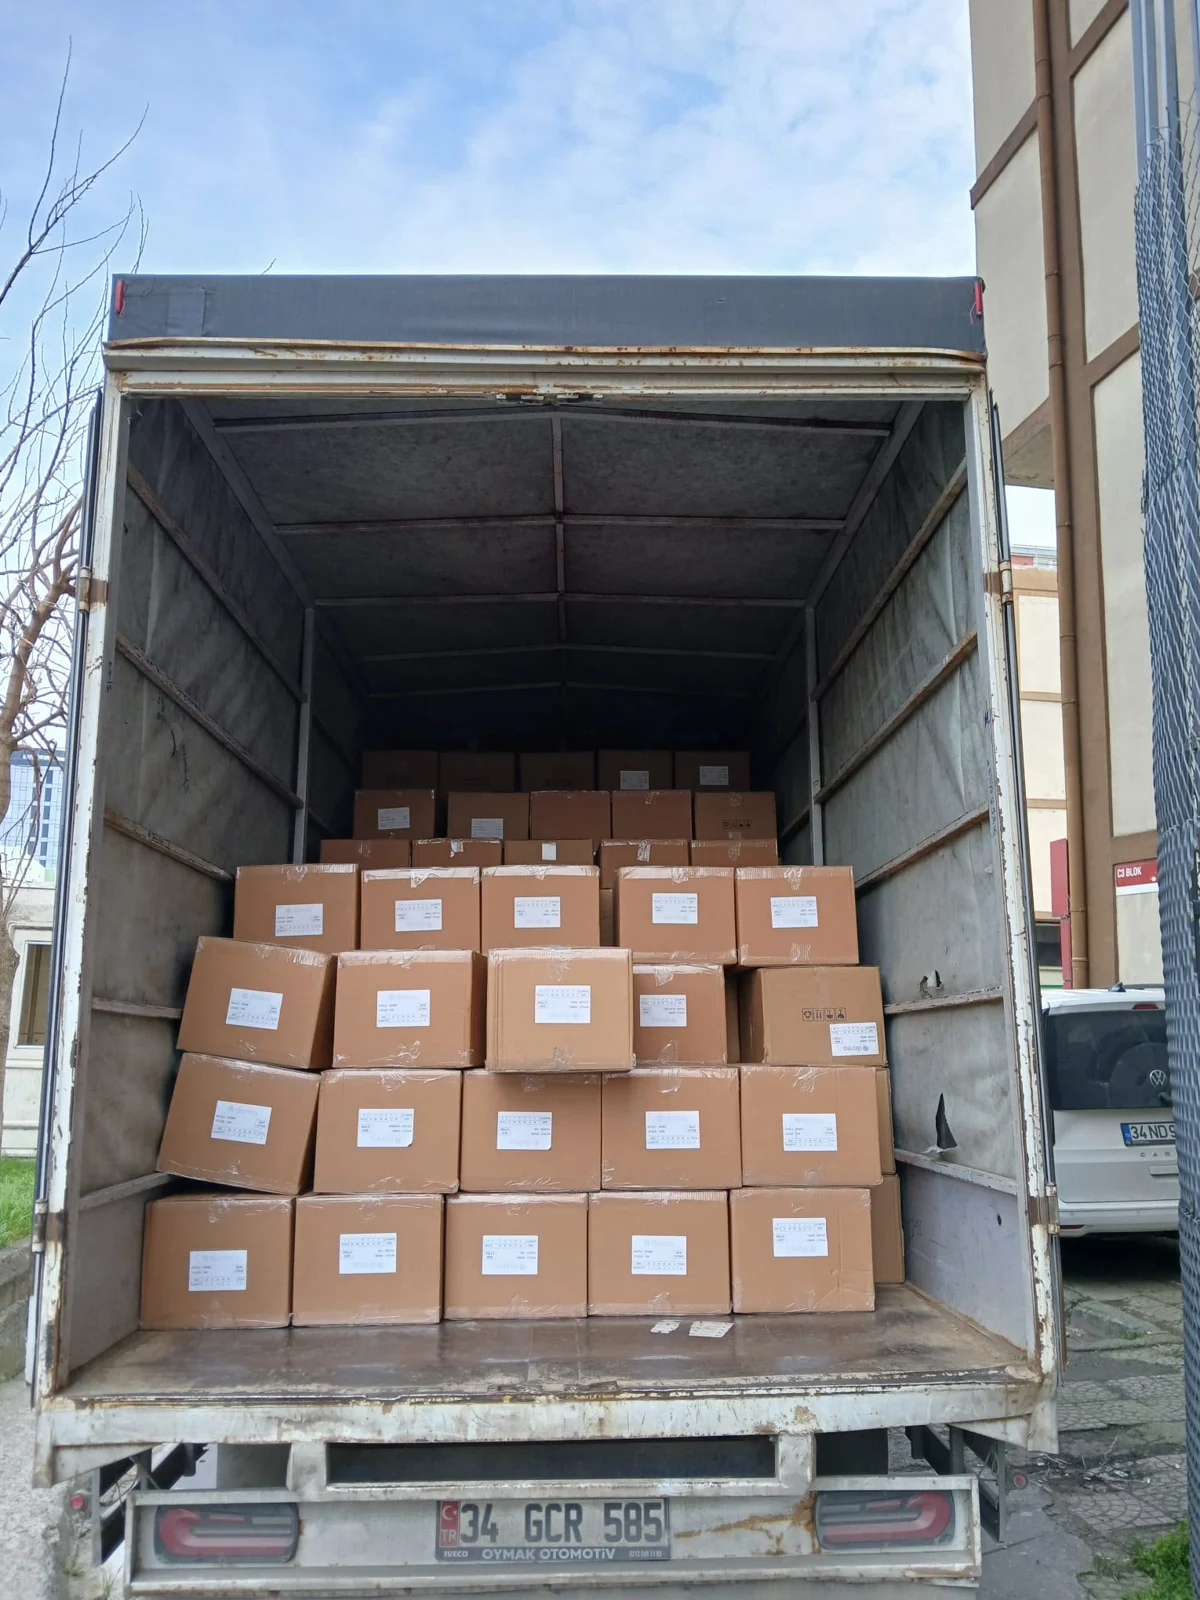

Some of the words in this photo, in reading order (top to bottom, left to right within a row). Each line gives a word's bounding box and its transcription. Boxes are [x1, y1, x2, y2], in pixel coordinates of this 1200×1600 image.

[1117, 869, 1125, 878] C3
[1126, 866, 1142, 877] BLOK
[1130, 1125, 1147, 1139] 34
[461, 1503, 499, 1543] 34
[525, 1502, 583, 1543] GCR
[604, 1502, 662, 1543] 585
[441, 1529, 457, 1541] TR
[444, 1550, 469, 1558] IVECO
[482, 1548, 535, 1560] OYMAK
